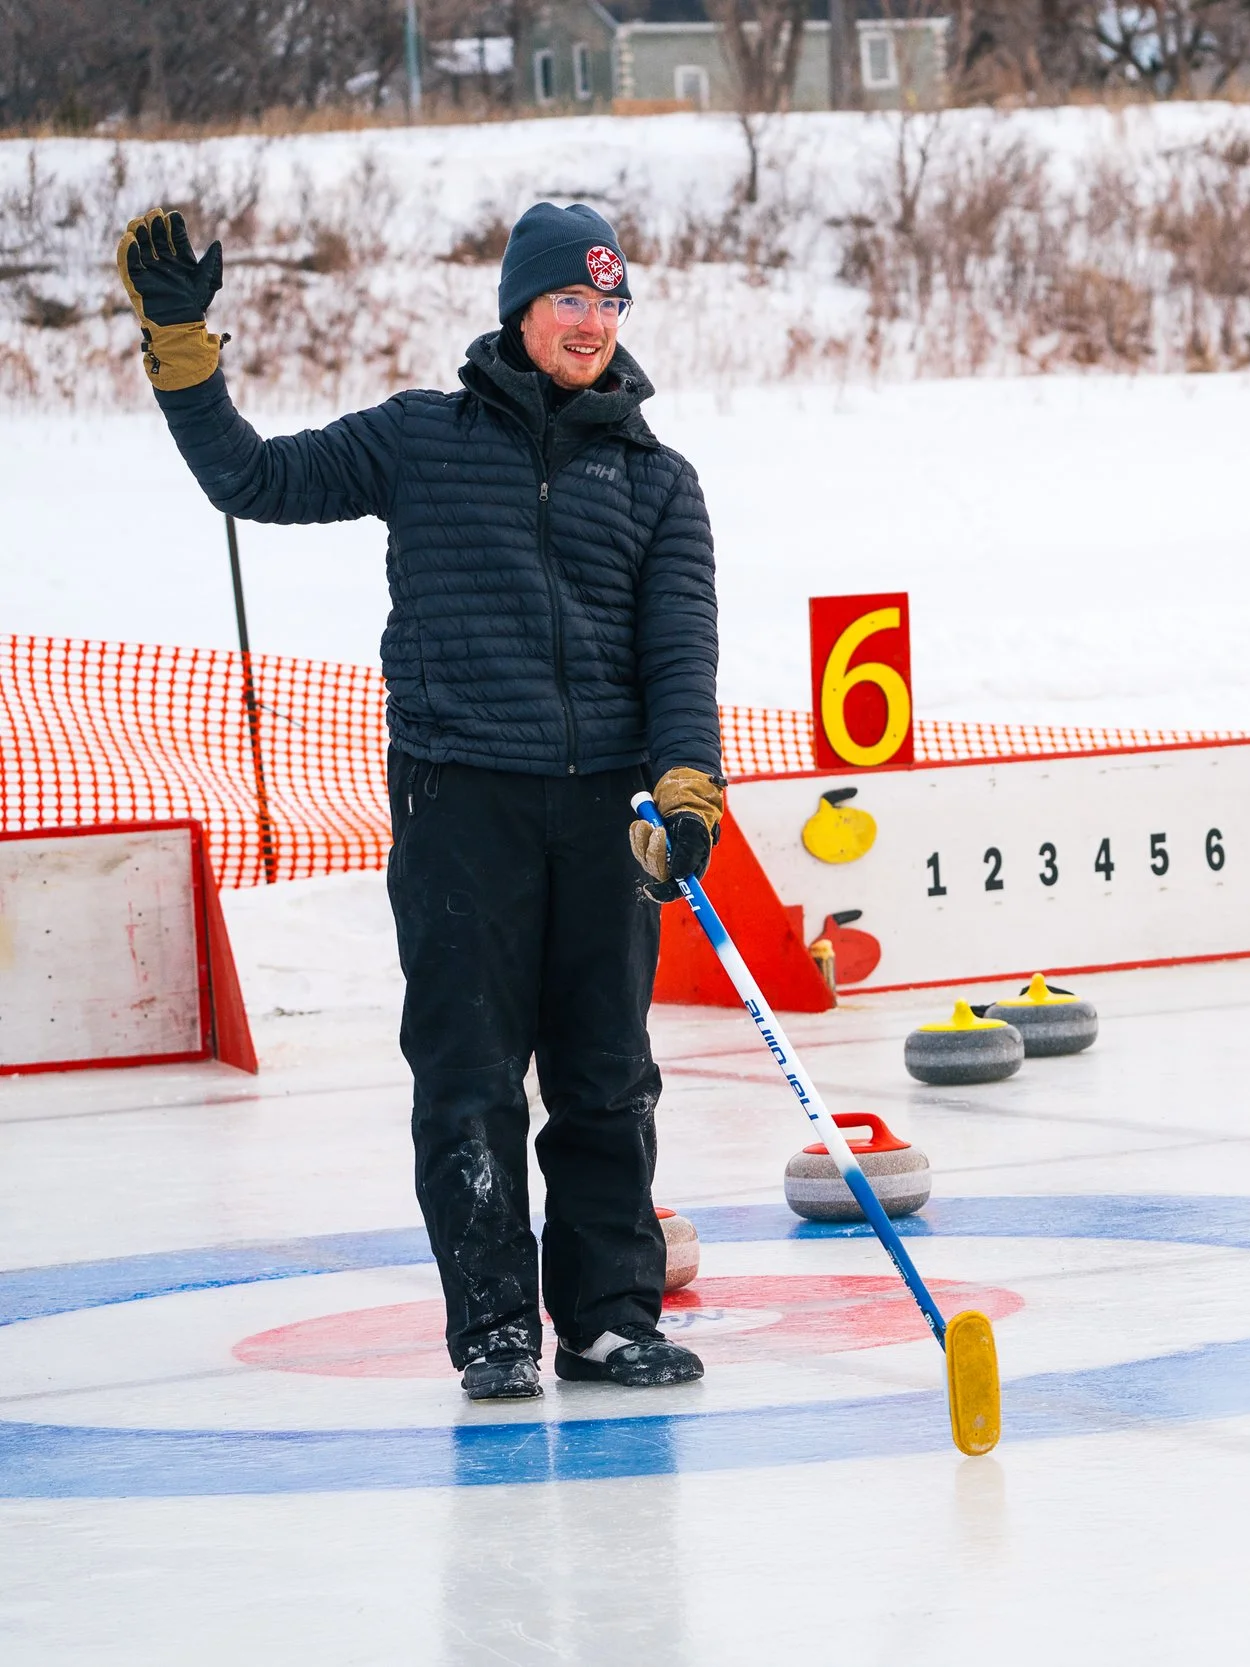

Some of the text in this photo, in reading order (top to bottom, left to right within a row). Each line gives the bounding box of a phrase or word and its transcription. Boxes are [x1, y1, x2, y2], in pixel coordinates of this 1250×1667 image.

[821, 607, 911, 767] 6
[926, 852, 947, 897] 1
[983, 847, 1004, 892] 2
[1038, 842, 1060, 887] 3
[1094, 837, 1115, 881] 4
[1150, 832, 1169, 877] 5
[1205, 828, 1225, 872] 6
